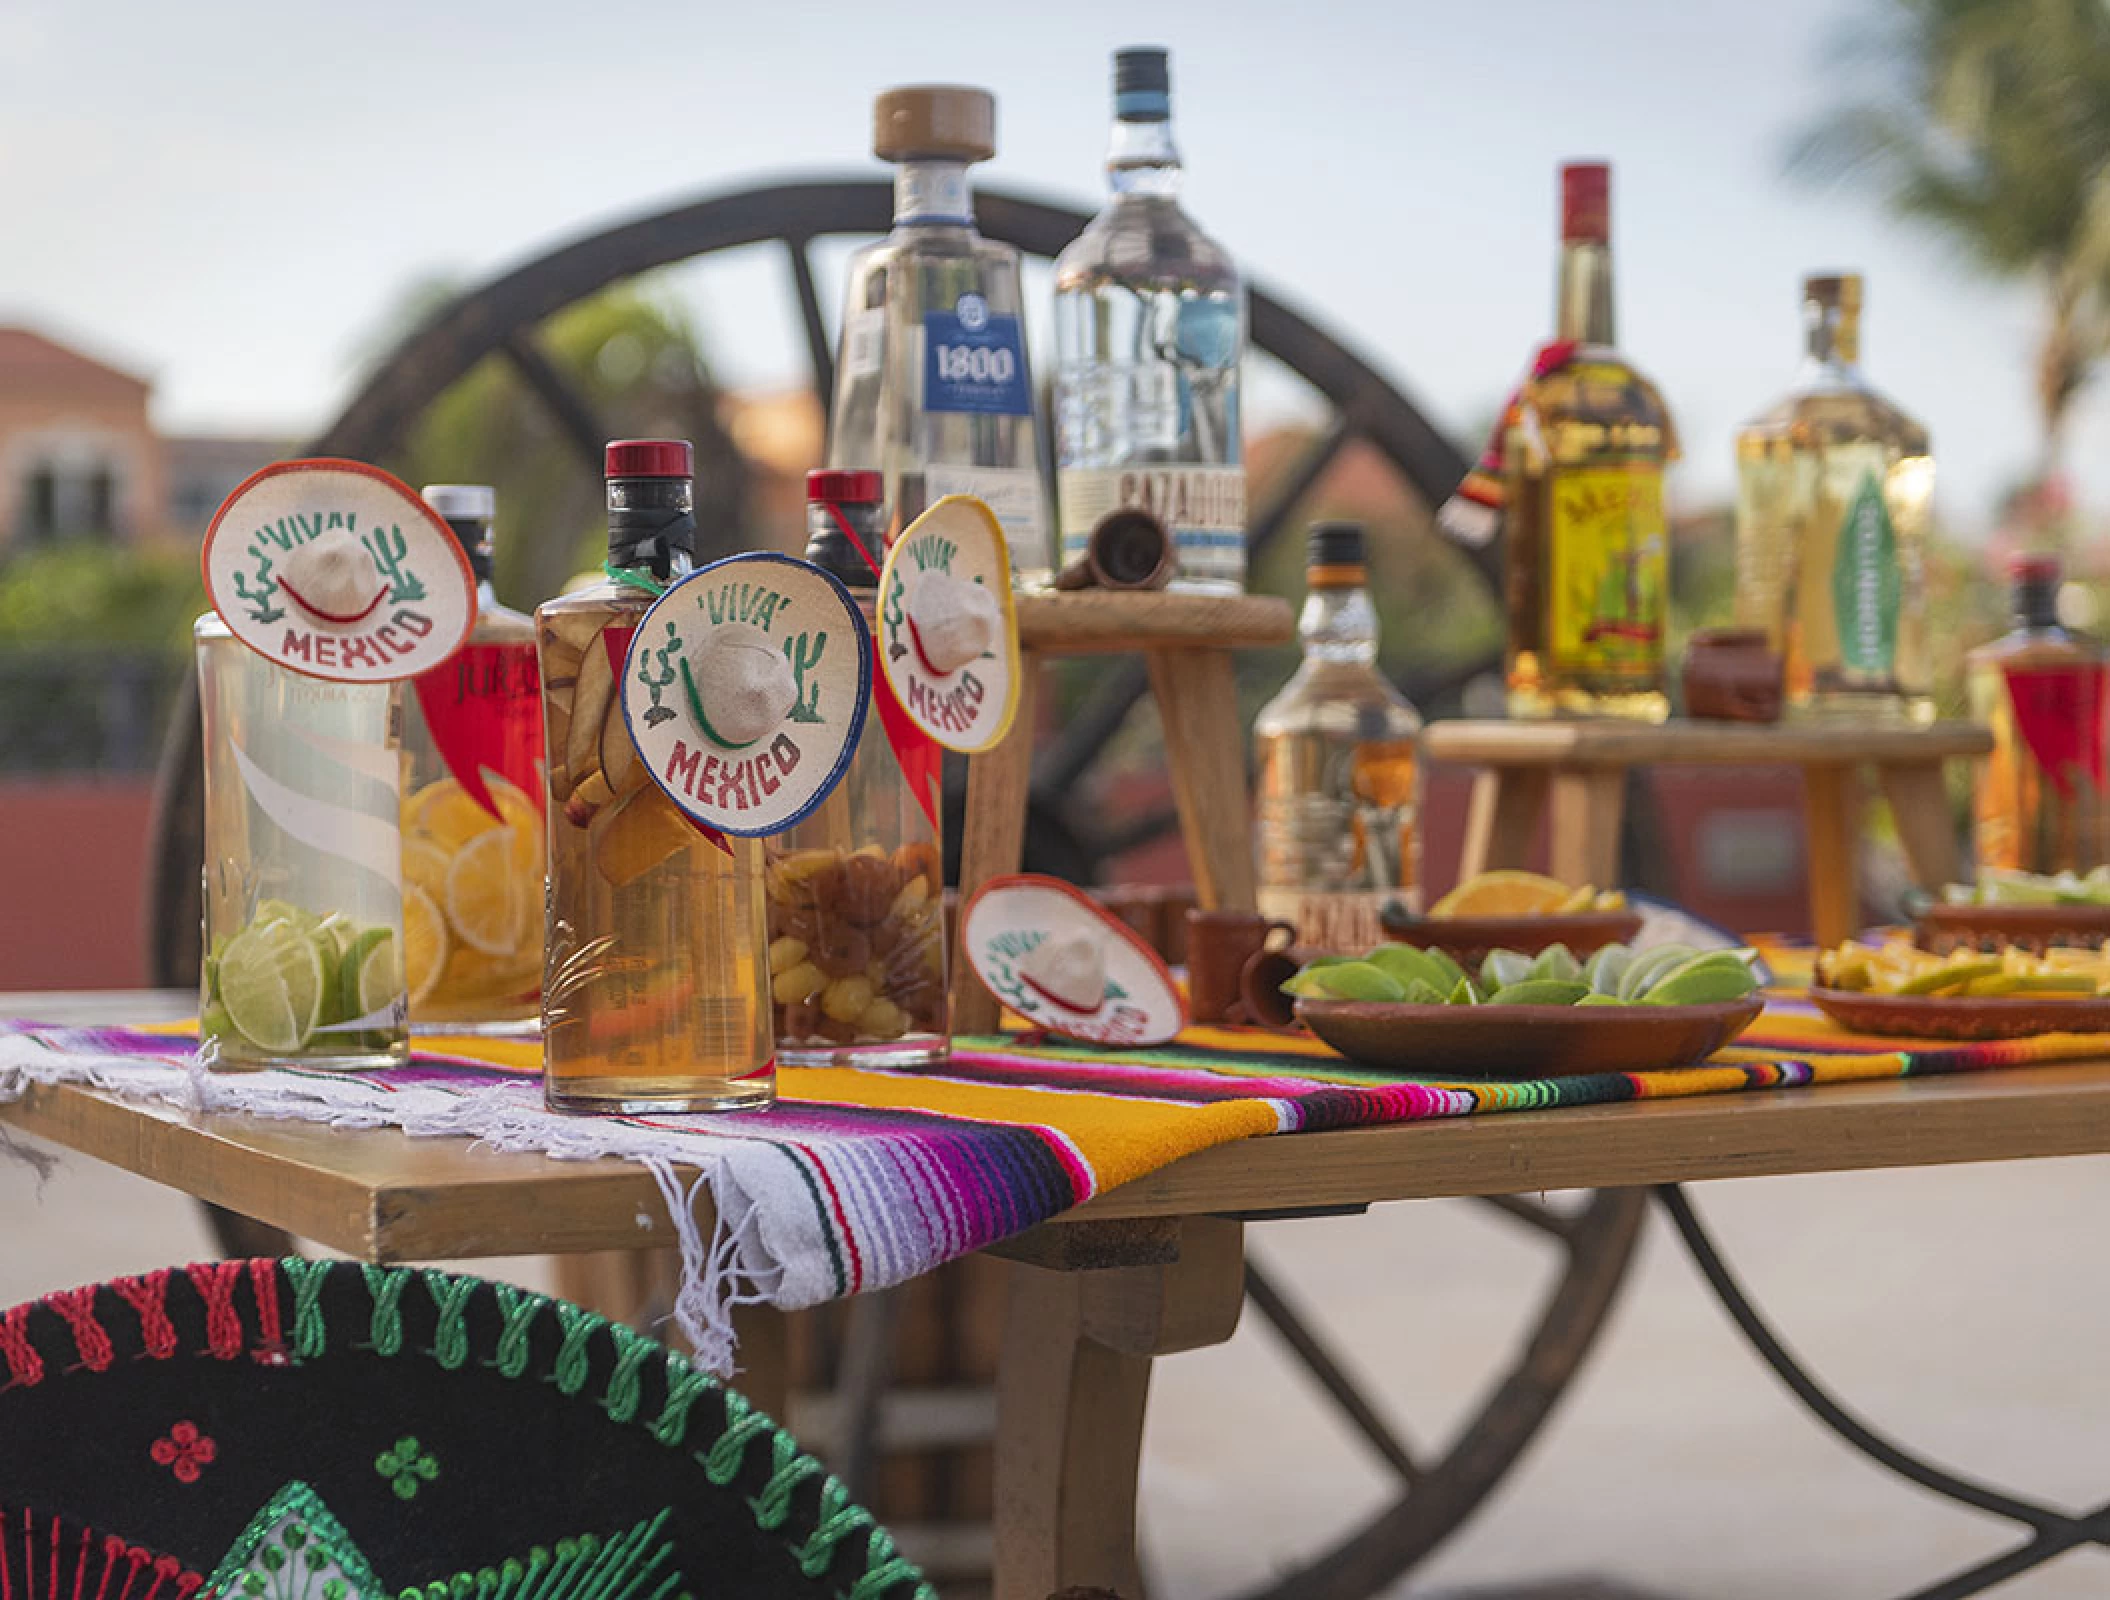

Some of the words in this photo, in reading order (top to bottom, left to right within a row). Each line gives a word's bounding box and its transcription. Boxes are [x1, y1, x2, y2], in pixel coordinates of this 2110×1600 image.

[936, 344, 1014, 383] 1800
[281, 608, 433, 668] MEXICO
[908, 669, 984, 732] MEXICO
[665, 740, 801, 810] MEXICO
